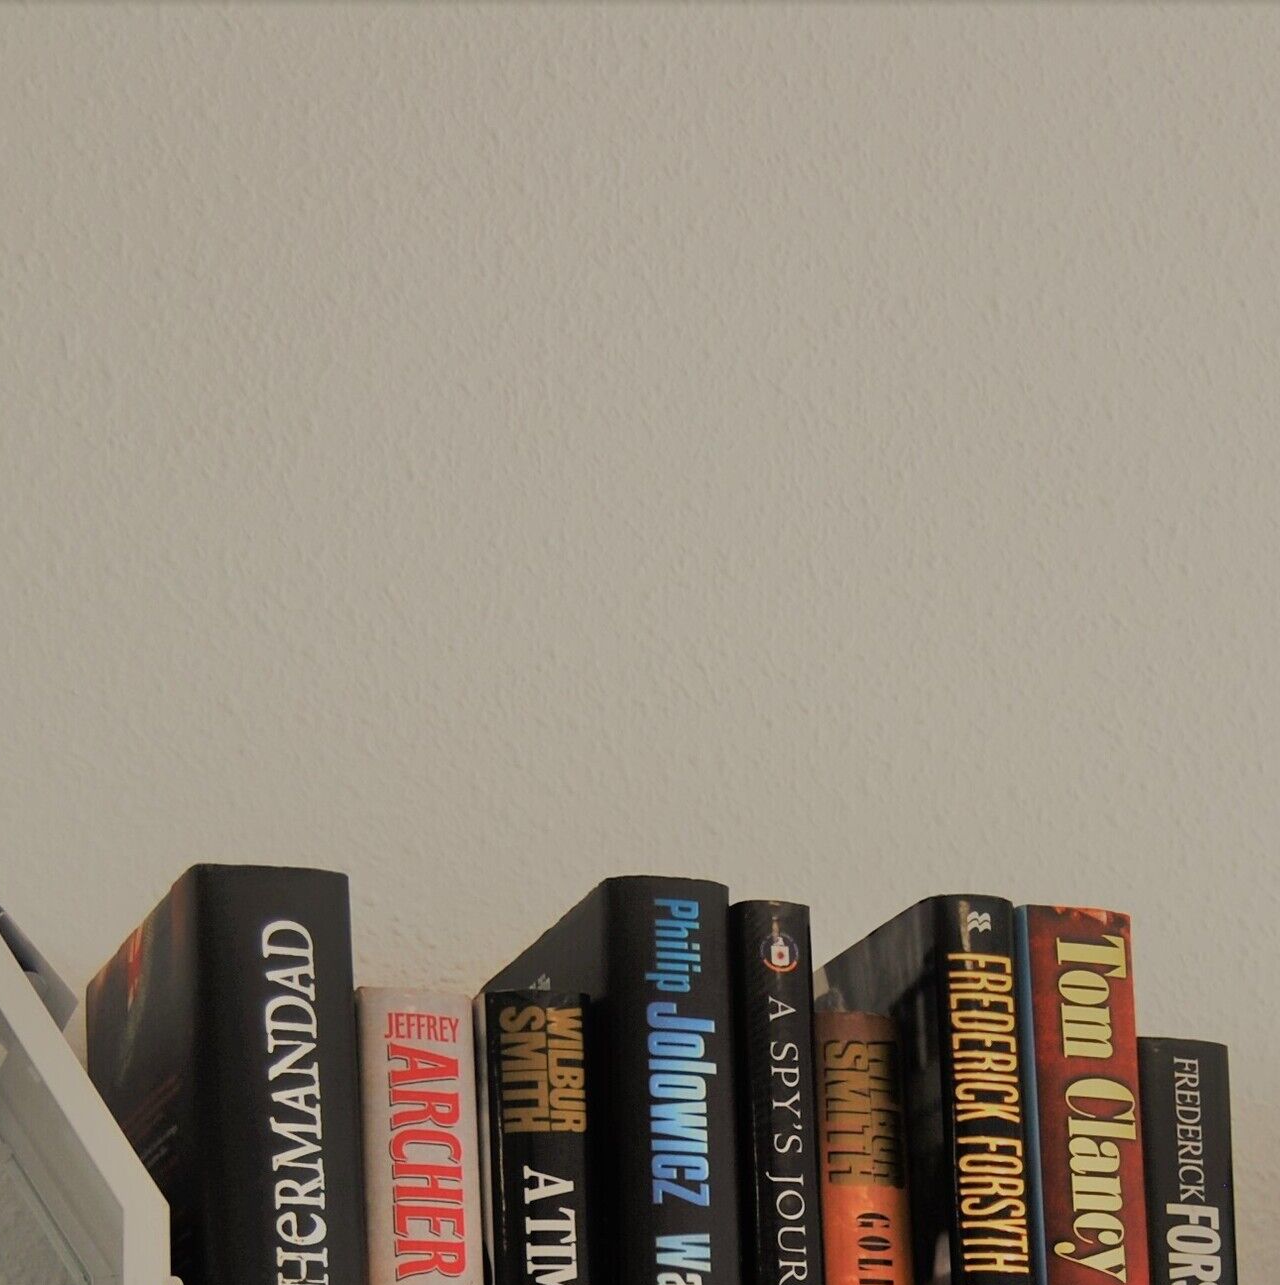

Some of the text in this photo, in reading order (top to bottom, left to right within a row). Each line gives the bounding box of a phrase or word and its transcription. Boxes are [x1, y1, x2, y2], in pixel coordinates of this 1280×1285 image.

[645, 897, 702, 993] Philip
[768, 995, 797, 1022] A
[384, 1012, 460, 1044] JEFFREY
[499, 1005, 552, 1134] SMITH
[545, 1006, 587, 1133] WILBUR
[387, 1042, 468, 1282] ARCHER
[770, 1041, 804, 1155] SPY'S
[823, 1039, 874, 1184] SMITH
[948, 952, 1030, 1275] FREDERICK FORSYTH
[1053, 933, 1137, 1285] Tom Clancy
[1172, 1055, 1206, 1202] FREDERICK
[523, 1165, 575, 1205] A
